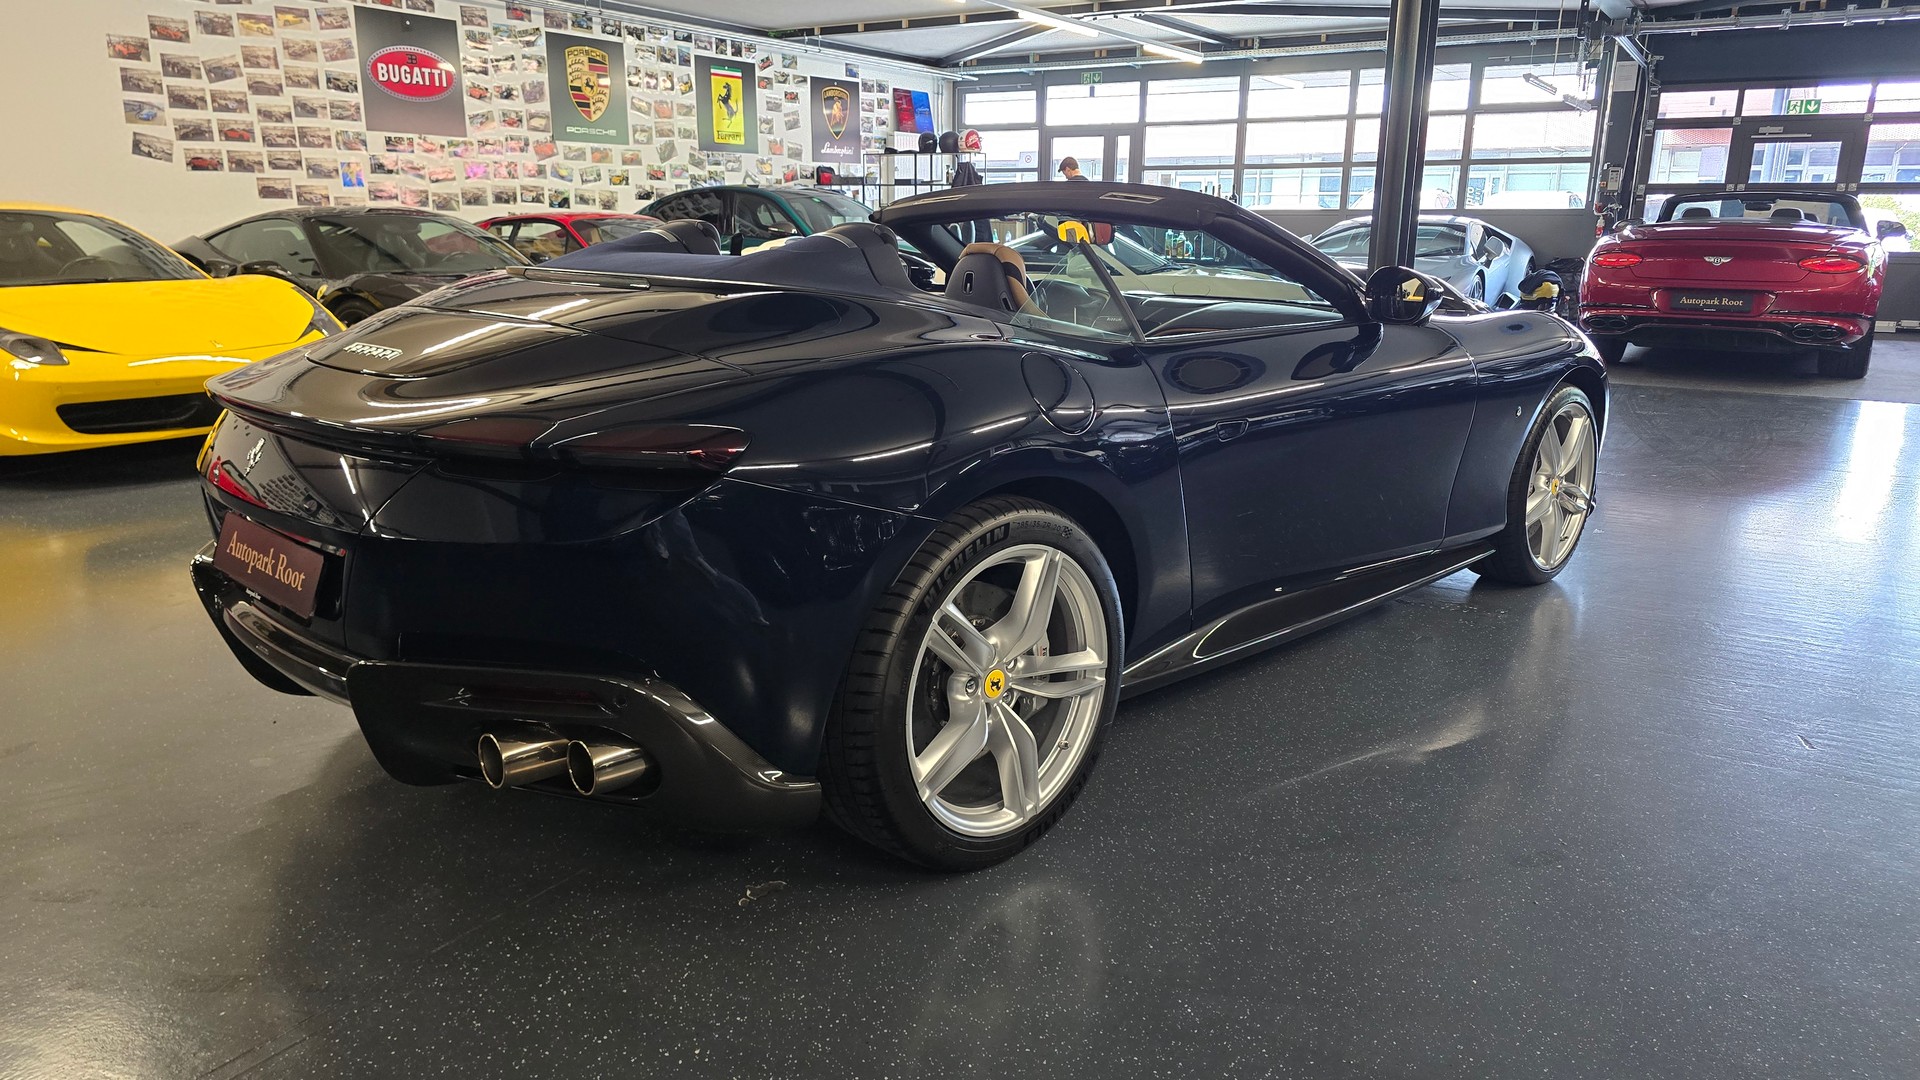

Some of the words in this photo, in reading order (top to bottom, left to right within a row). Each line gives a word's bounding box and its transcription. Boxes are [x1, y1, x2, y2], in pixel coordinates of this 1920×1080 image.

[567, 49, 607, 62] PORSCHE
[377, 62, 447, 88] BUGATTI
[566, 126, 617, 137] PORSCHE
[717, 130, 742, 141] Ferrari
[1680, 296, 1720, 307] Autopark
[1721, 297, 1744, 306] Root
[226, 530, 275, 576] Autopark
[275, 553, 306, 591] Root
[923, 524, 1005, 610] MICHELIN
